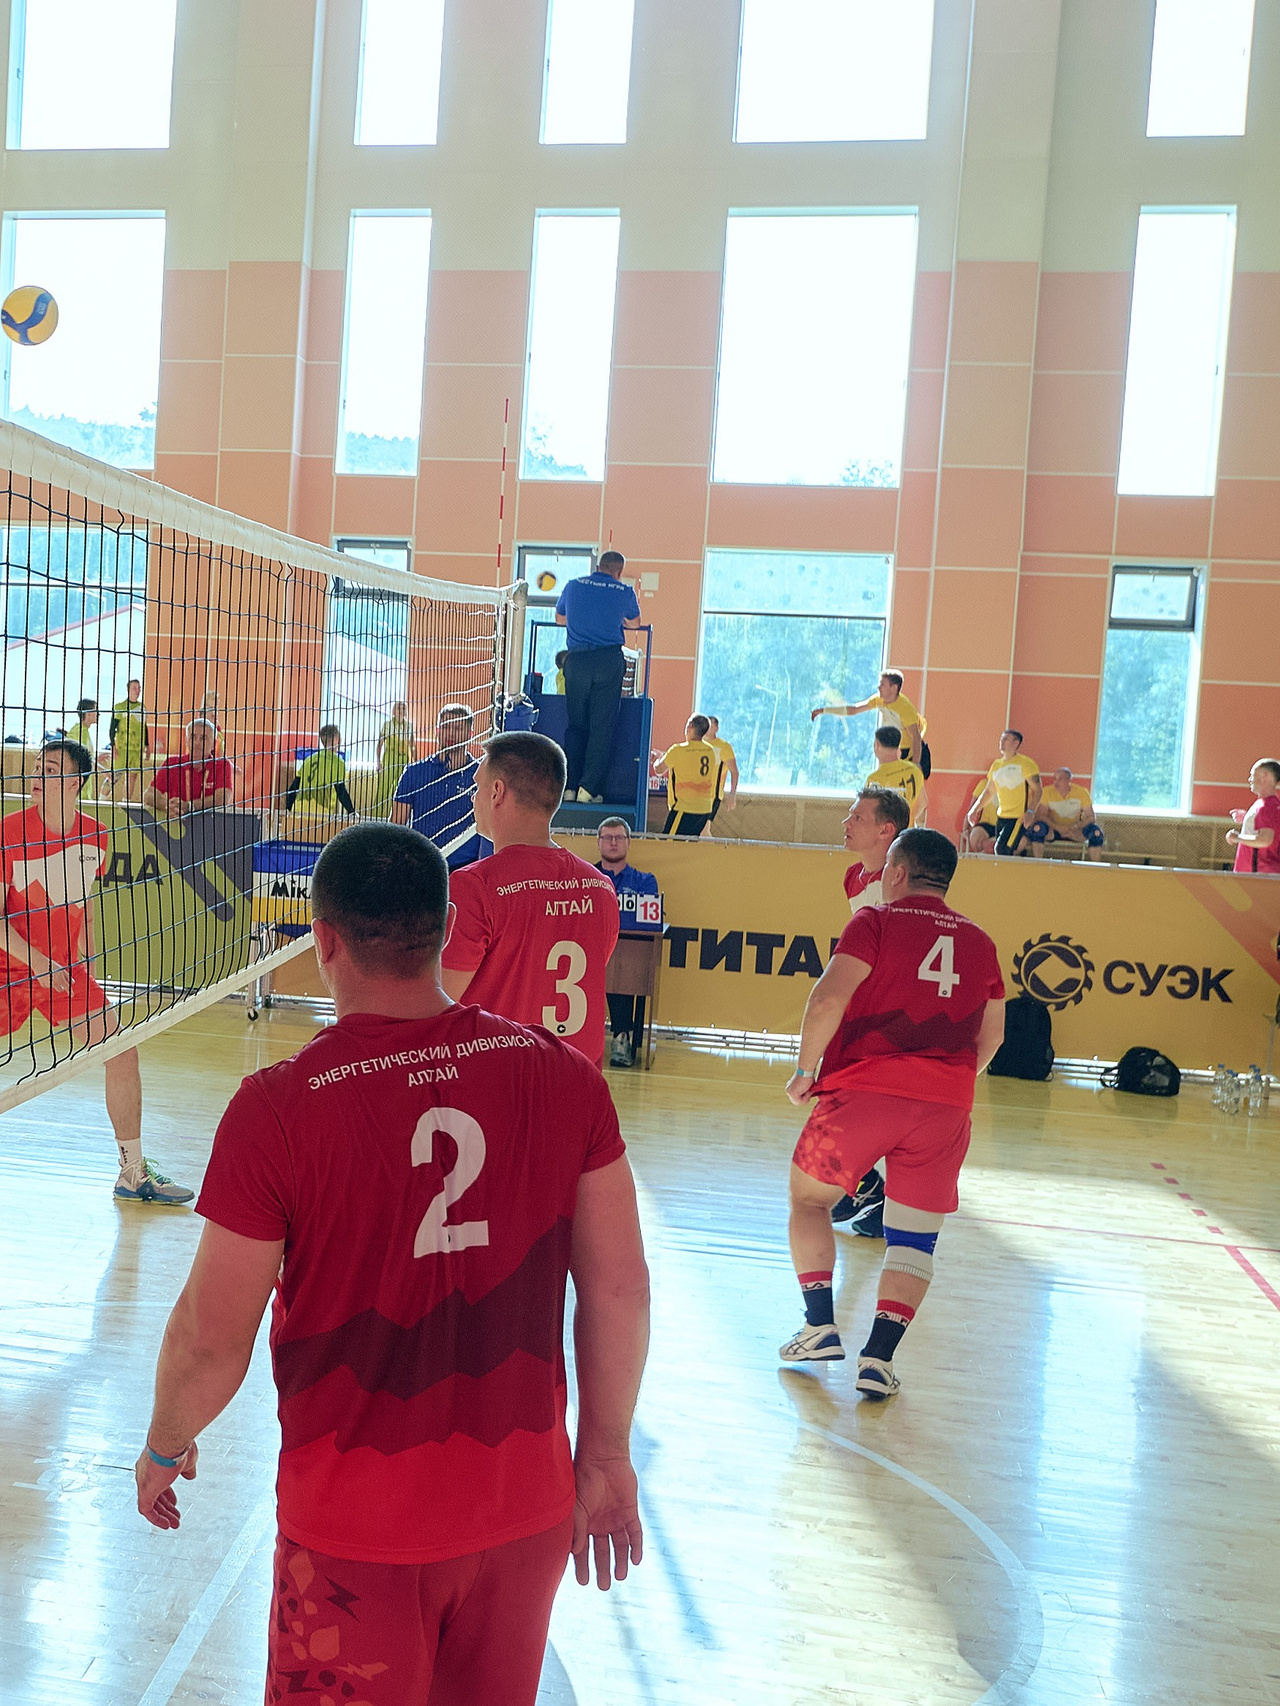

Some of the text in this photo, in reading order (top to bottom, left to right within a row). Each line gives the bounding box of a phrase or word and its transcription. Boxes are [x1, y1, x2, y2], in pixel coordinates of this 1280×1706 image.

[700, 755, 710, 777] 8
[496, 877, 580, 897] ЭНЕРГЕТИЧЕСКИЙ
[545, 894, 594, 917] АЛТАЙ
[640, 901, 660, 921] 13
[934, 919, 958, 930] АЛТАЙ
[917, 934, 961, 999] 4
[541, 940, 588, 1037] 3
[1102, 959, 1235, 1004] СУЭК
[307, 1042, 452, 1091] ЭНЕРГЕТИЧЕСКИЙ
[407, 1063, 459, 1087] АЛТАЙ
[410, 1106, 490, 1259] 2
